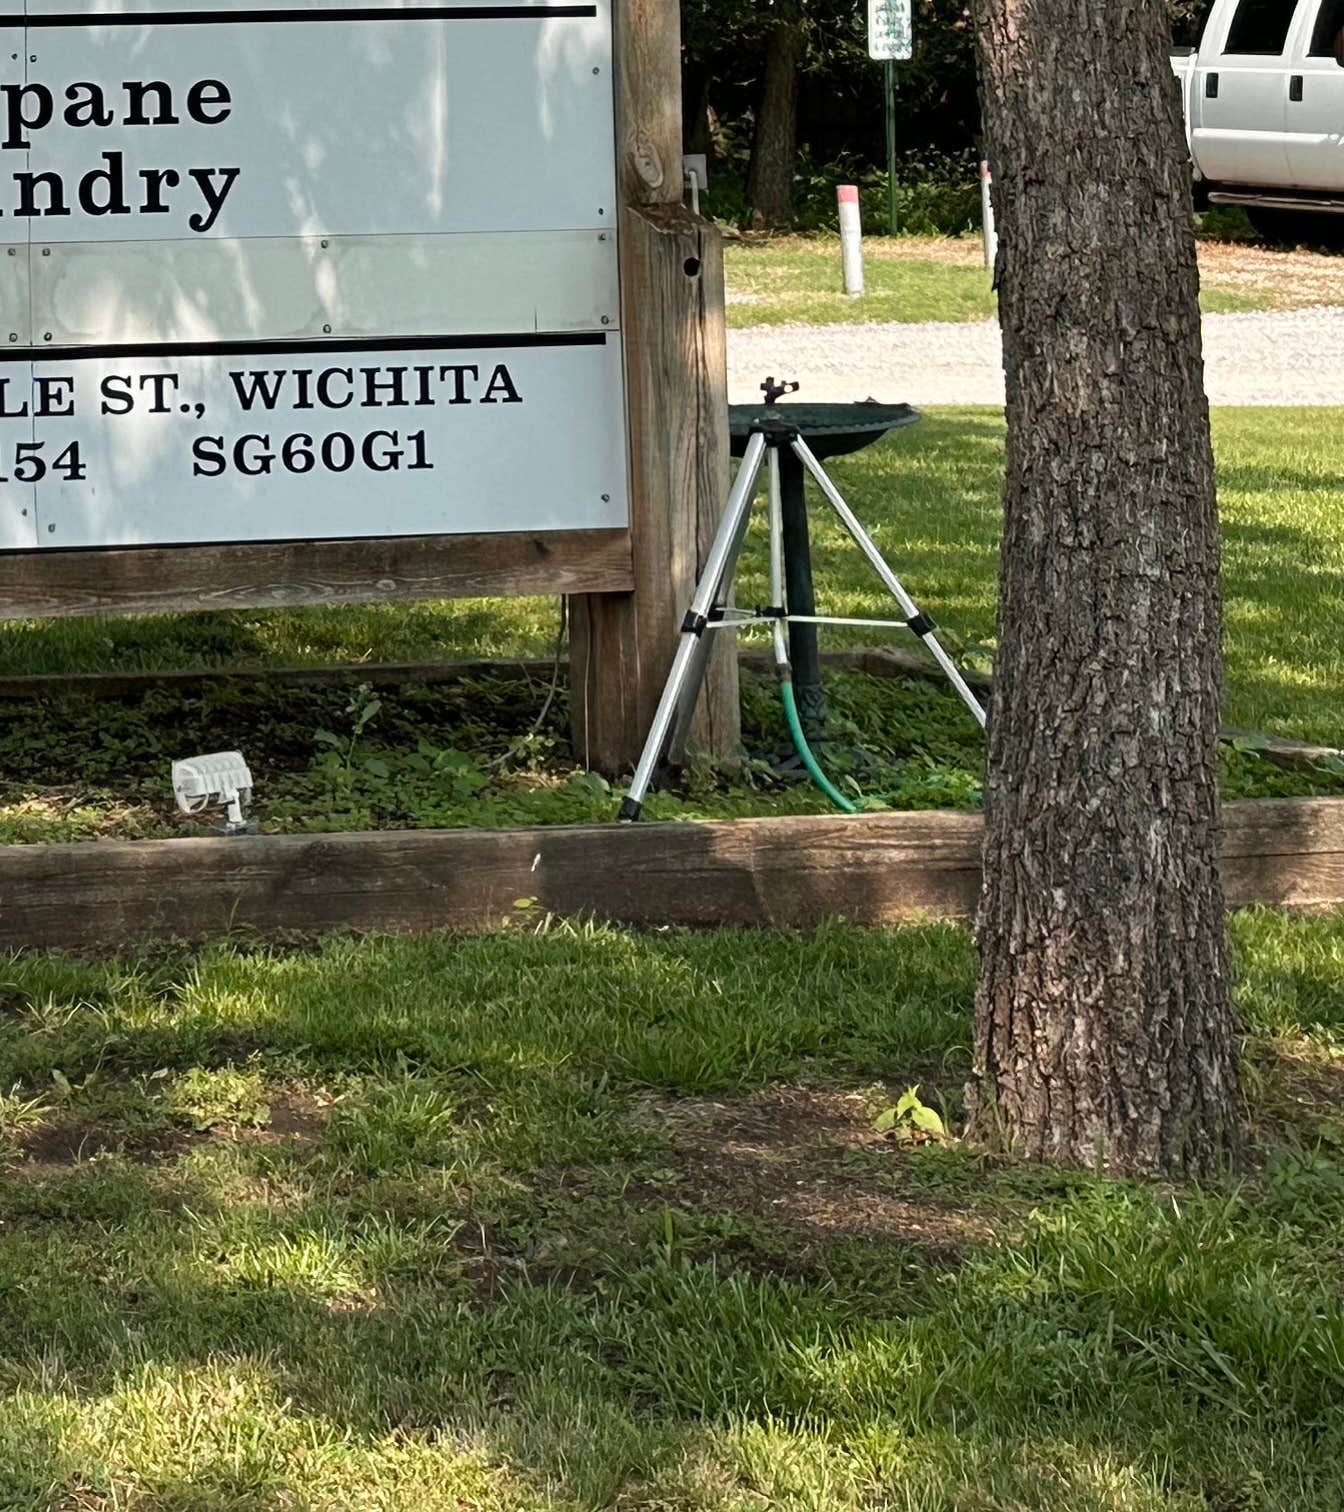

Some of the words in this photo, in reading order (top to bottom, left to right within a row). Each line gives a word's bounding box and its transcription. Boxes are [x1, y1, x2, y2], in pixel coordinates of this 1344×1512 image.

[100, 374, 206, 419] ST.,
[229, 364, 524, 410] WICHITA
[193, 430, 434, 477] SG60G1
